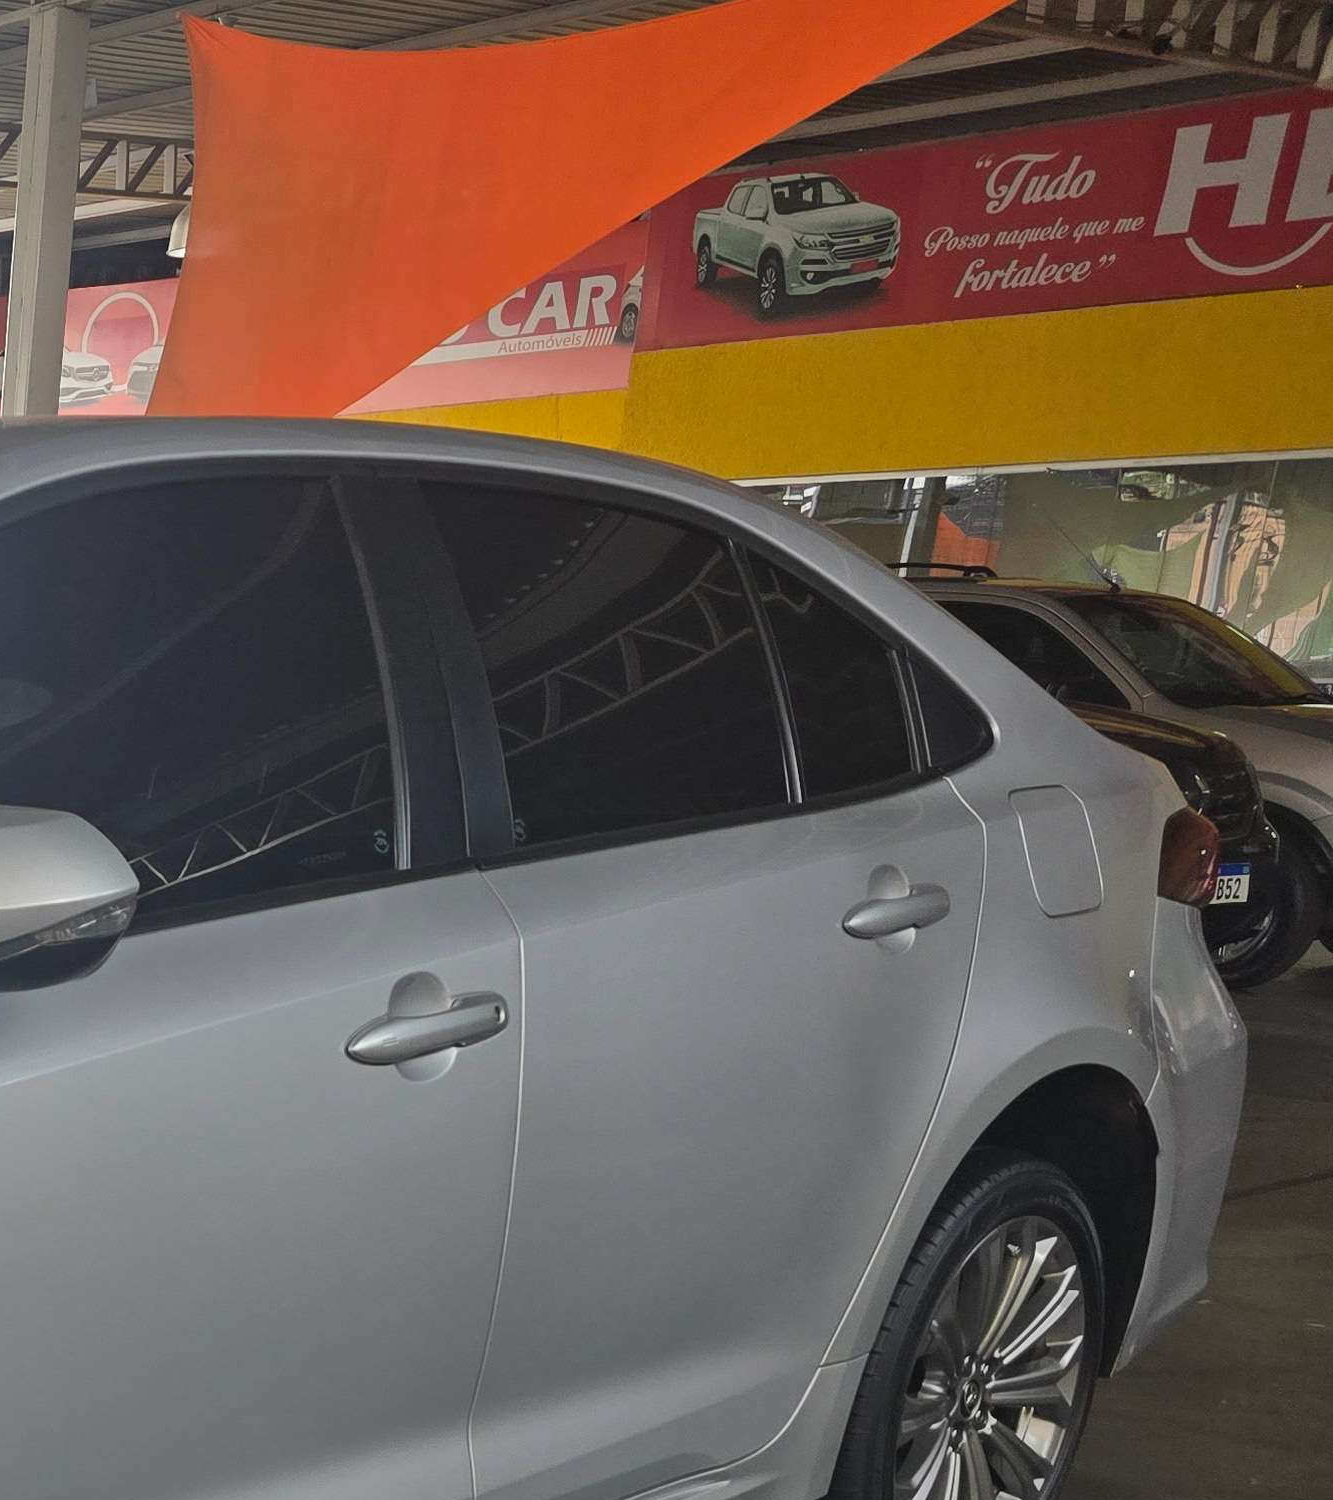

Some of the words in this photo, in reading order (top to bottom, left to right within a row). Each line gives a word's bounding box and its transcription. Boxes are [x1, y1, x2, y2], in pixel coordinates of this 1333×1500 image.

[924, 226, 989, 257] Posso
[993, 217, 1070, 249] naquele
[1073, 219, 1110, 243] que
[1113, 216, 1145, 234] me
[488, 274, 617, 337] CAR
[497, 333, 583, 355] Automóveis
